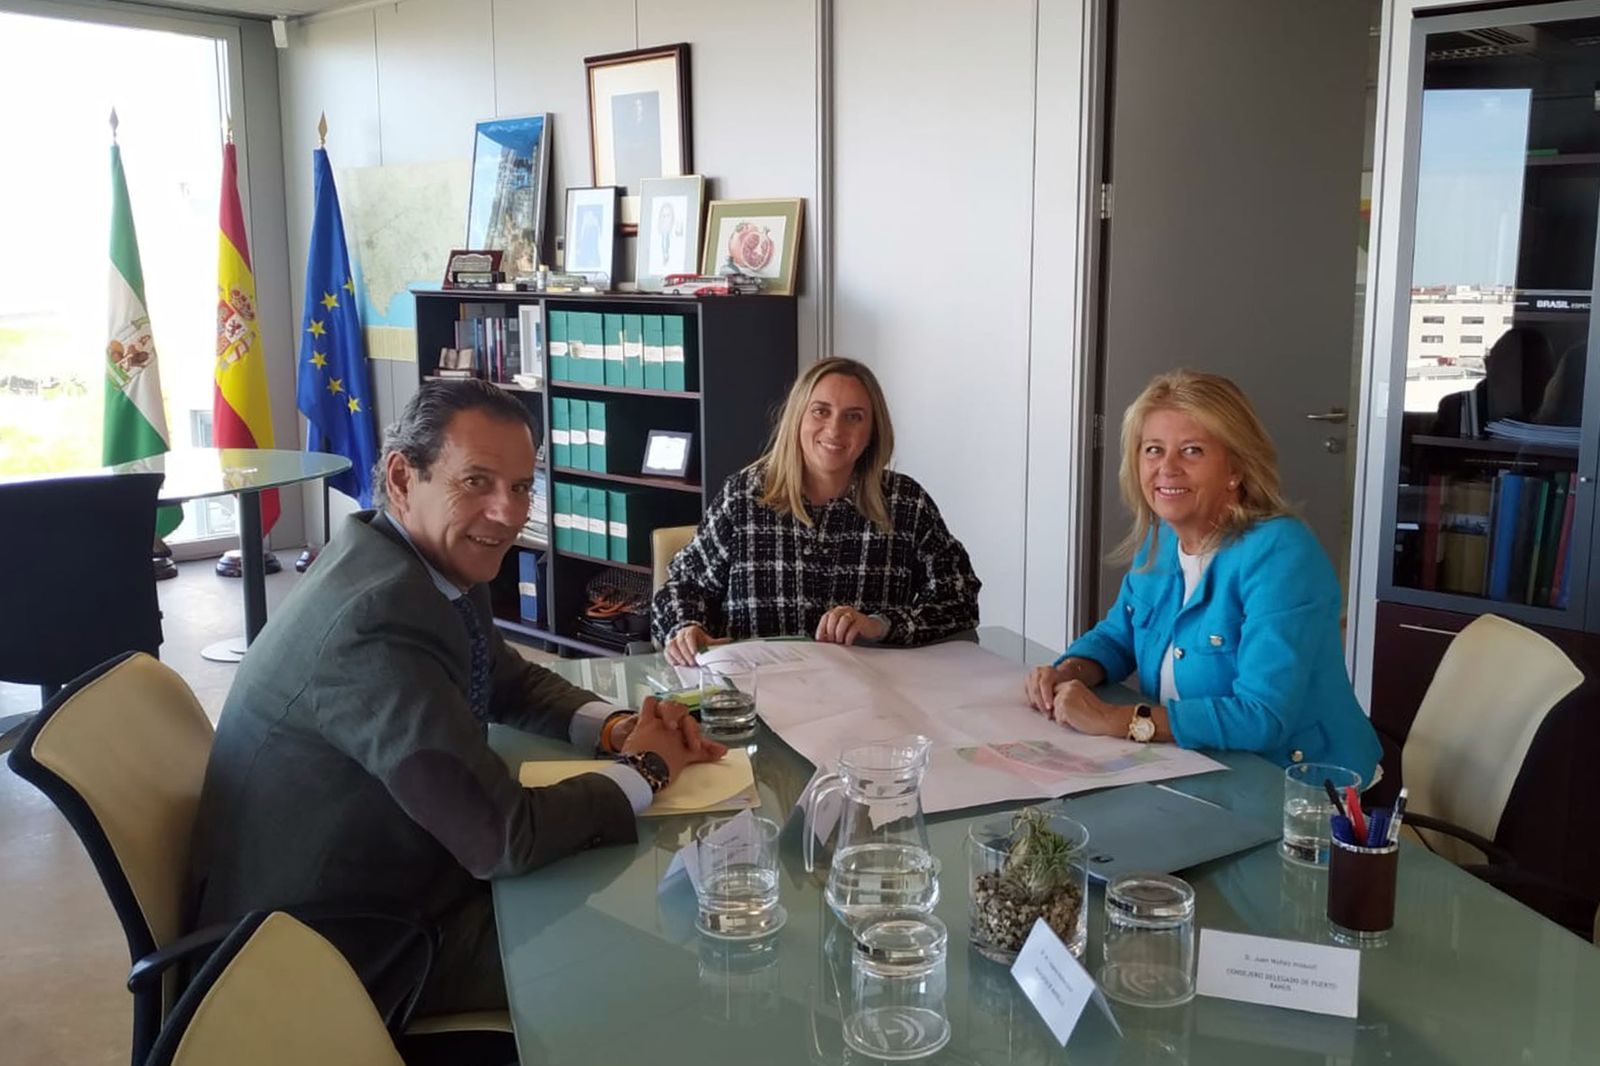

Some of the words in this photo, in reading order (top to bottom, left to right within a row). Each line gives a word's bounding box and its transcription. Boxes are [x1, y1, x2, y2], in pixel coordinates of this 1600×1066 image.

[1536, 300, 1570, 308] BRASIL
[1226, 968, 1263, 980] CONSEJERO
[1264, 973, 1300, 985] DELEGADO
[1300, 978, 1310, 986] DE
[1311, 980, 1338, 990] PUERTO
